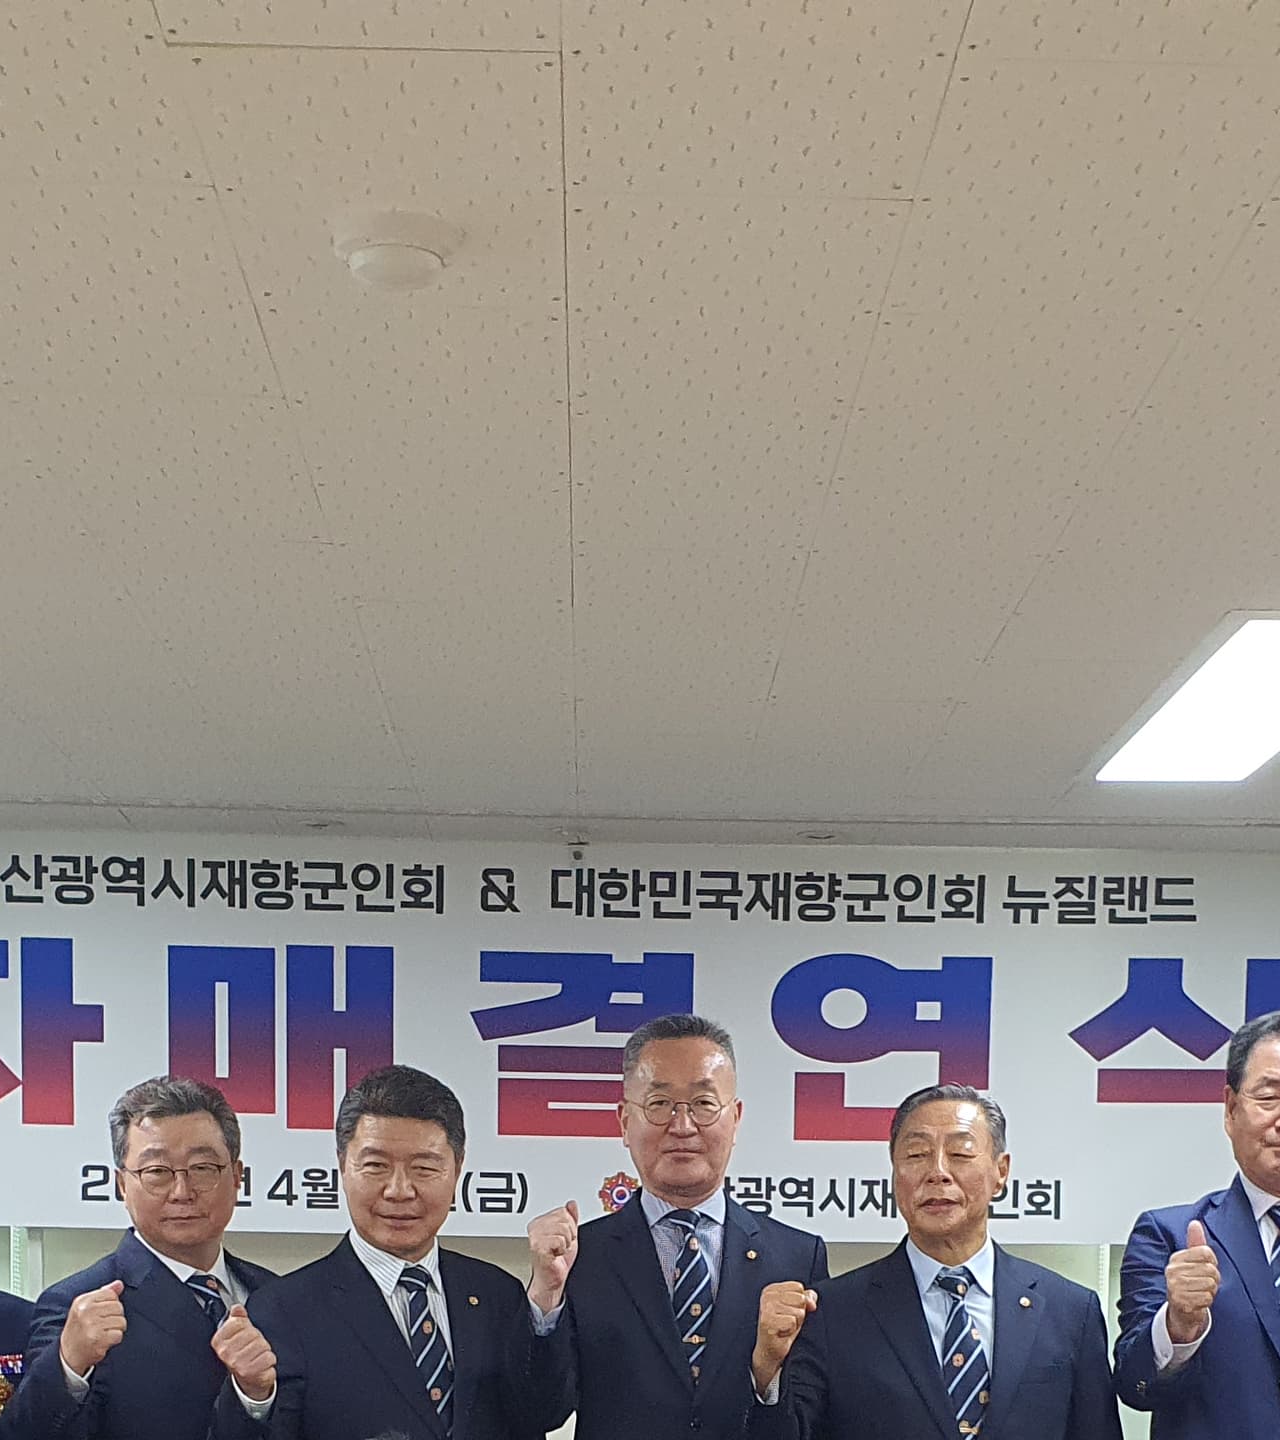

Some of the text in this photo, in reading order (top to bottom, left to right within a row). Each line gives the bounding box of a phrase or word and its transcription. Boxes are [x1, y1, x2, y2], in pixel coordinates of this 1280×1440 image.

[480, 866, 520, 913] &
[550, 867, 986, 924] 대한민국재향군인회
[1001, 874, 1198, 924] 뉴질랜드
[267, 1167, 340, 1210] 4월
